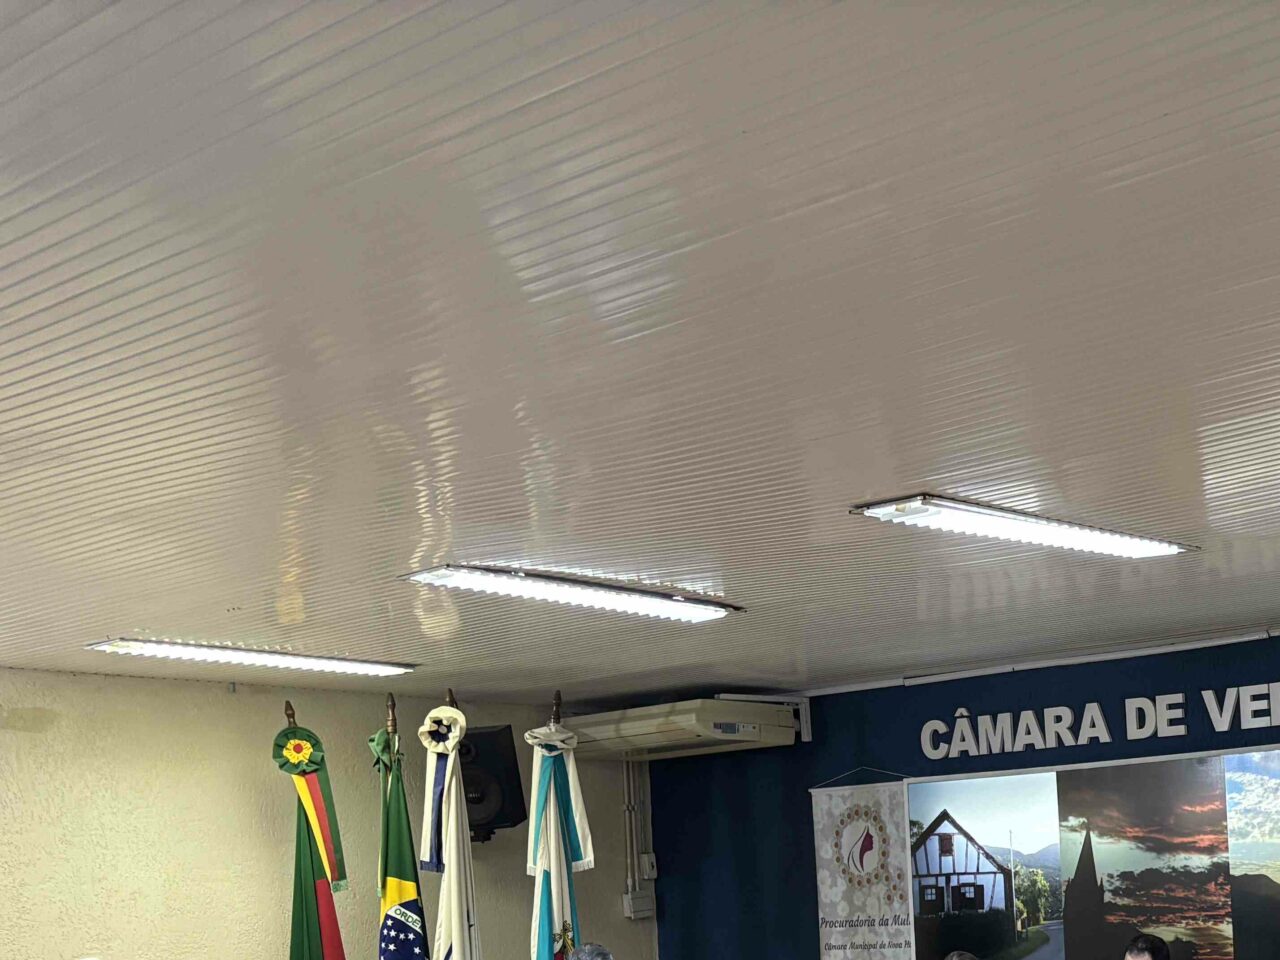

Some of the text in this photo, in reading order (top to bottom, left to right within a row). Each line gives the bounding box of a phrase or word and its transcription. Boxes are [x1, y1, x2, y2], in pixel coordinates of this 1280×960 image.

[920, 703, 1113, 761] CÂMARA
[1124, 692, 1188, 741] DE
[394, 908, 421, 929] ORDE
[820, 912, 911, 929] Procuradoria da Mul
[879, 940, 886, 949] de
